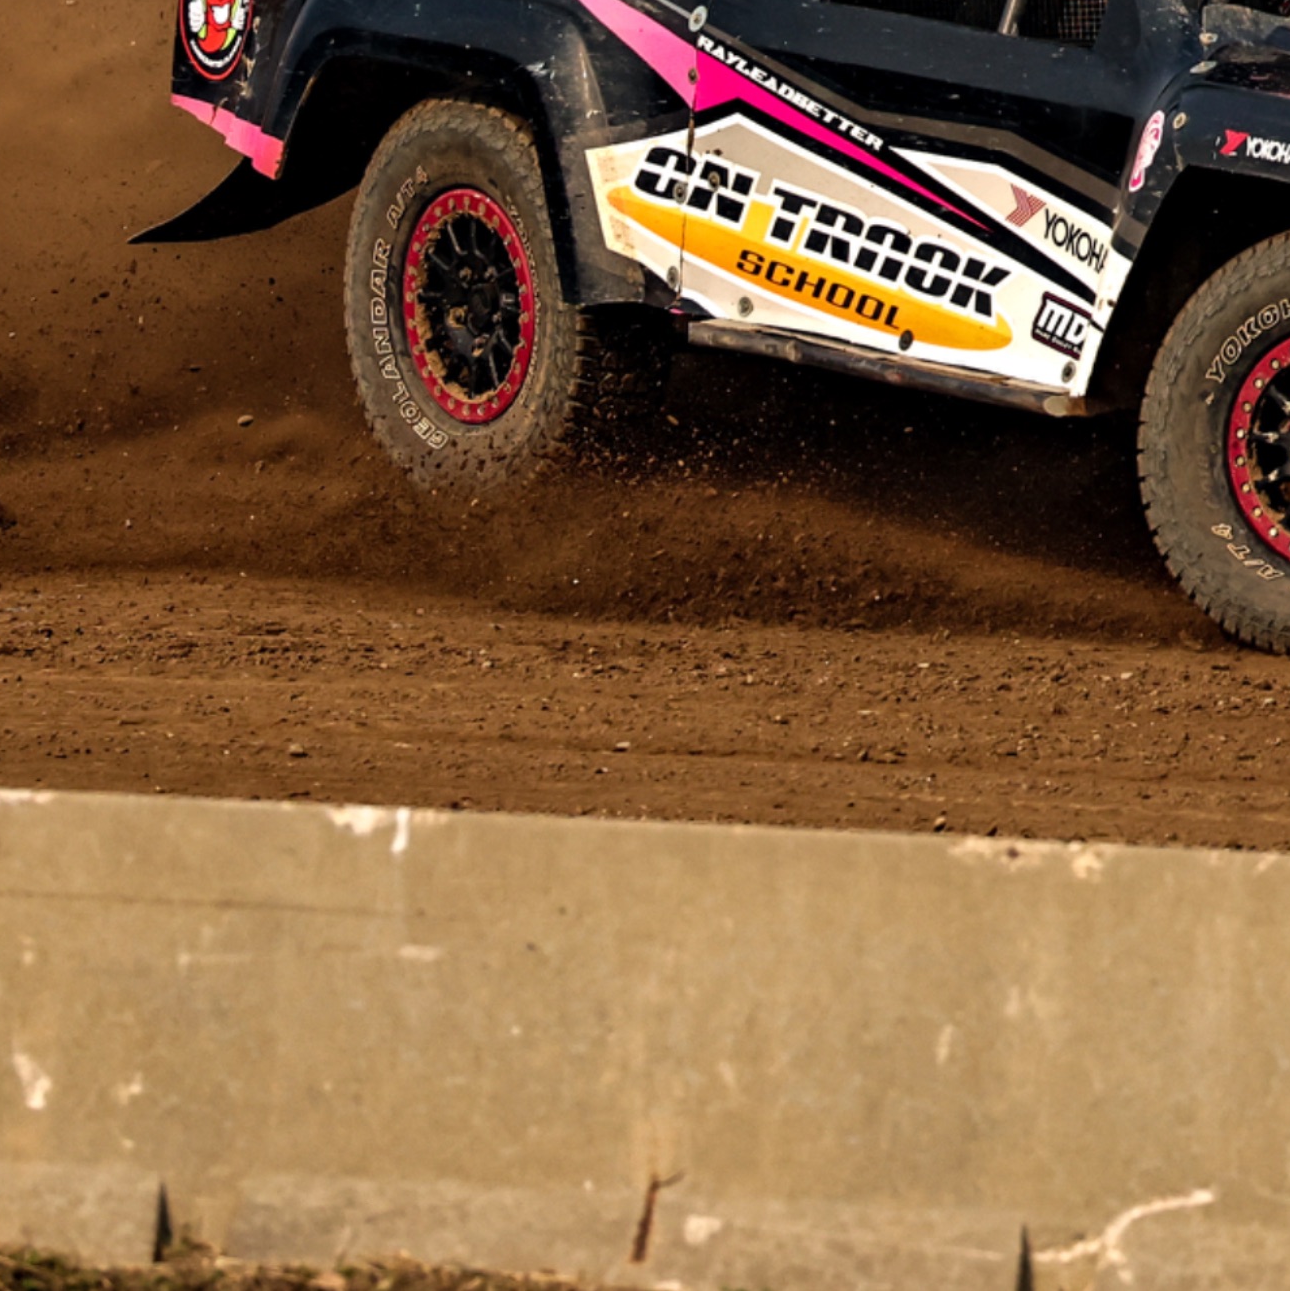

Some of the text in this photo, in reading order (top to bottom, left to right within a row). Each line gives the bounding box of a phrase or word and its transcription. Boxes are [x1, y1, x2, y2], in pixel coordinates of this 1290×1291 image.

[634, 145, 1012, 318] ON TRACK
[736, 248, 901, 330] SCHOOL
[369, 237, 451, 451] GEOLANDAR
